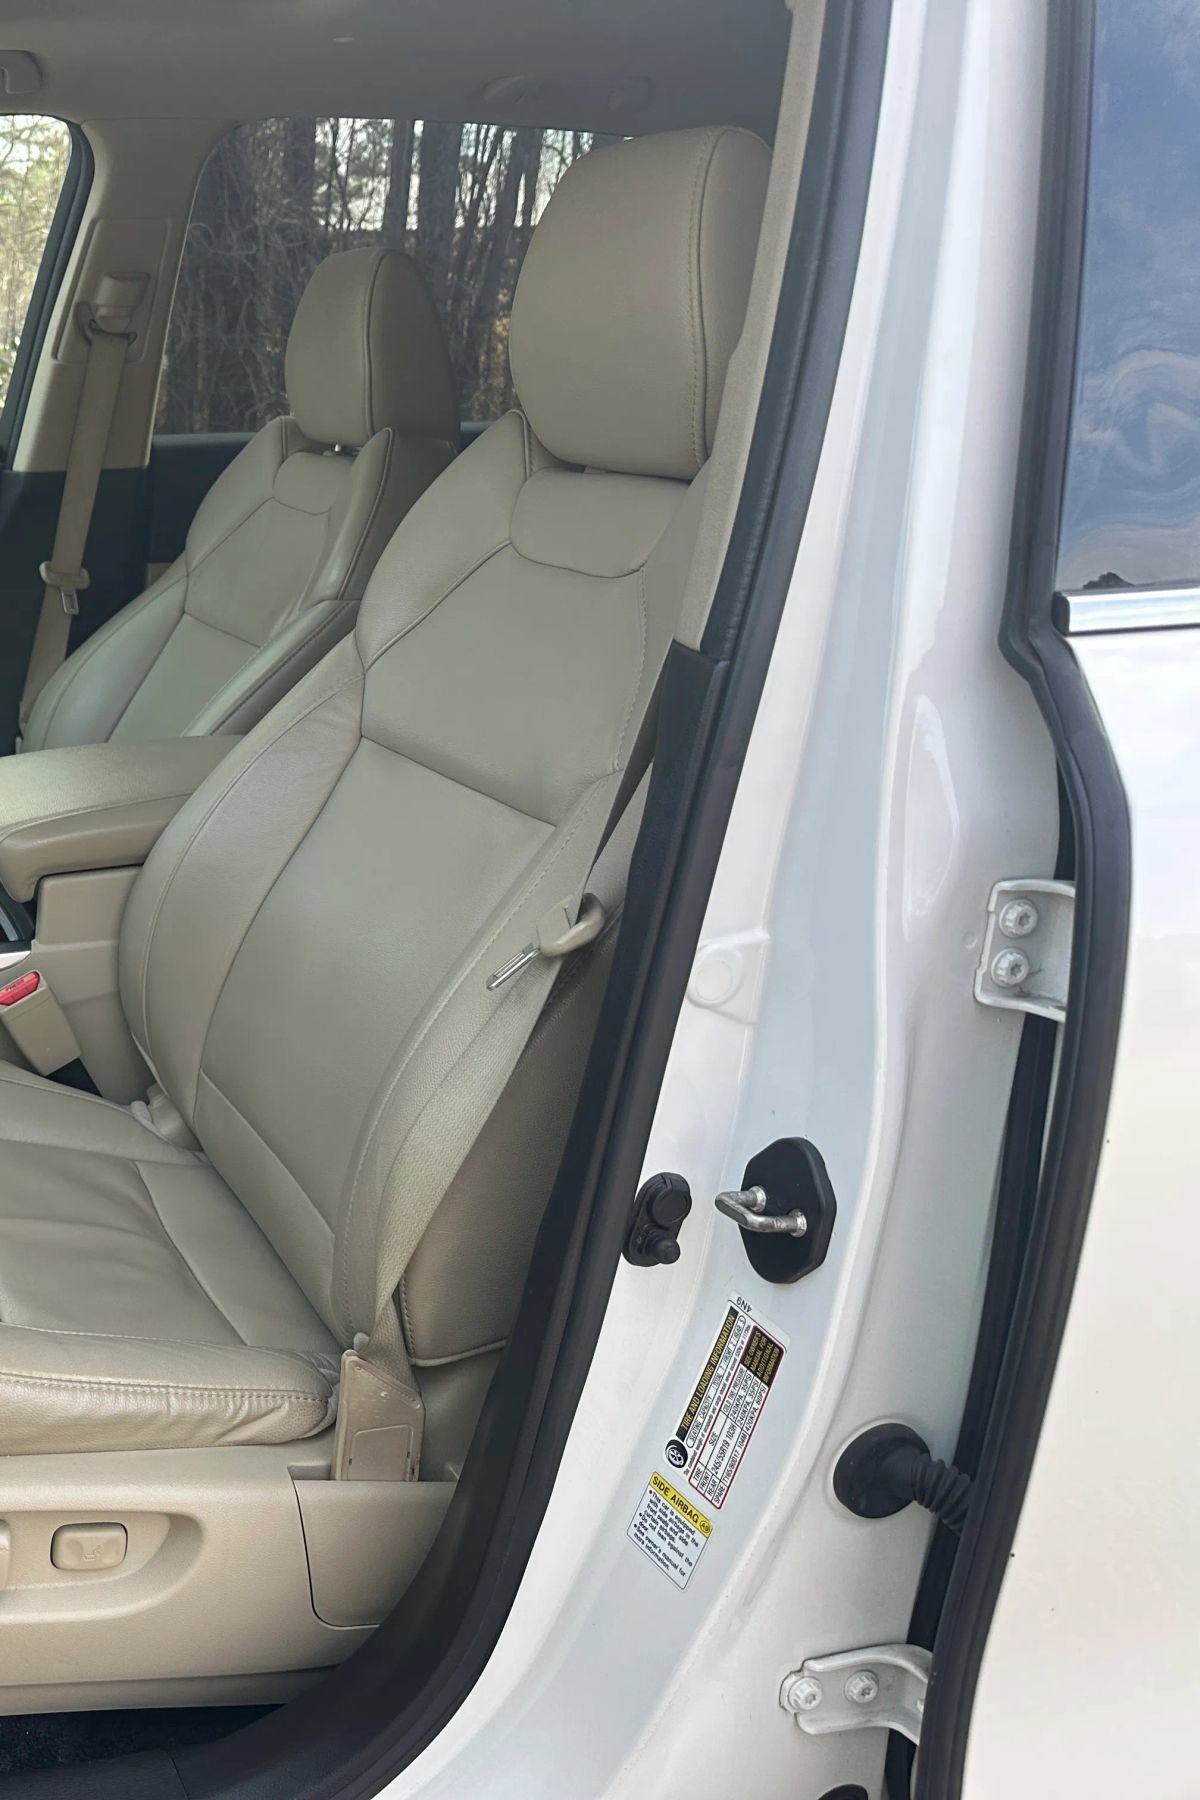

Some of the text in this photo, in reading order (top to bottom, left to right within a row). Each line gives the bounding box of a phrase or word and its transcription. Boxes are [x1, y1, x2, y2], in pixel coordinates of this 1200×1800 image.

[735, 1295, 752, 1314] 4N9
[743, 1353, 751, 1367] SEE
[749, 1335, 767, 1371] MANUAL FOR
[755, 1341, 773, 1377] ADDITIONAL
[681, 1313, 735, 1431] TIRE AND LOADING INFORMATION
[762, 1346, 780, 1383] INFORMATION
[740, 1372, 751, 1393] 35PSI
[748, 1378, 759, 1399] 35PSI
[755, 1384, 766, 1405] 60PSI
[688, 1419, 701, 1442] SEATING
[698, 1394, 712, 1420] CAPACITY
[708, 1430, 718, 1447] SIZE
[710, 1421, 737, 1475] 245/55R19 103H
[737, 1432, 747, 1449] 104M
[692, 1466, 702, 1482] TIRE
[698, 1470, 710, 1491] FRONT
[706, 1478, 717, 1496] REAR
[713, 1483, 725, 1504] SPARE
[651, 1475, 670, 1496] SIDE
[669, 1492, 700, 1523] AIRBAG
